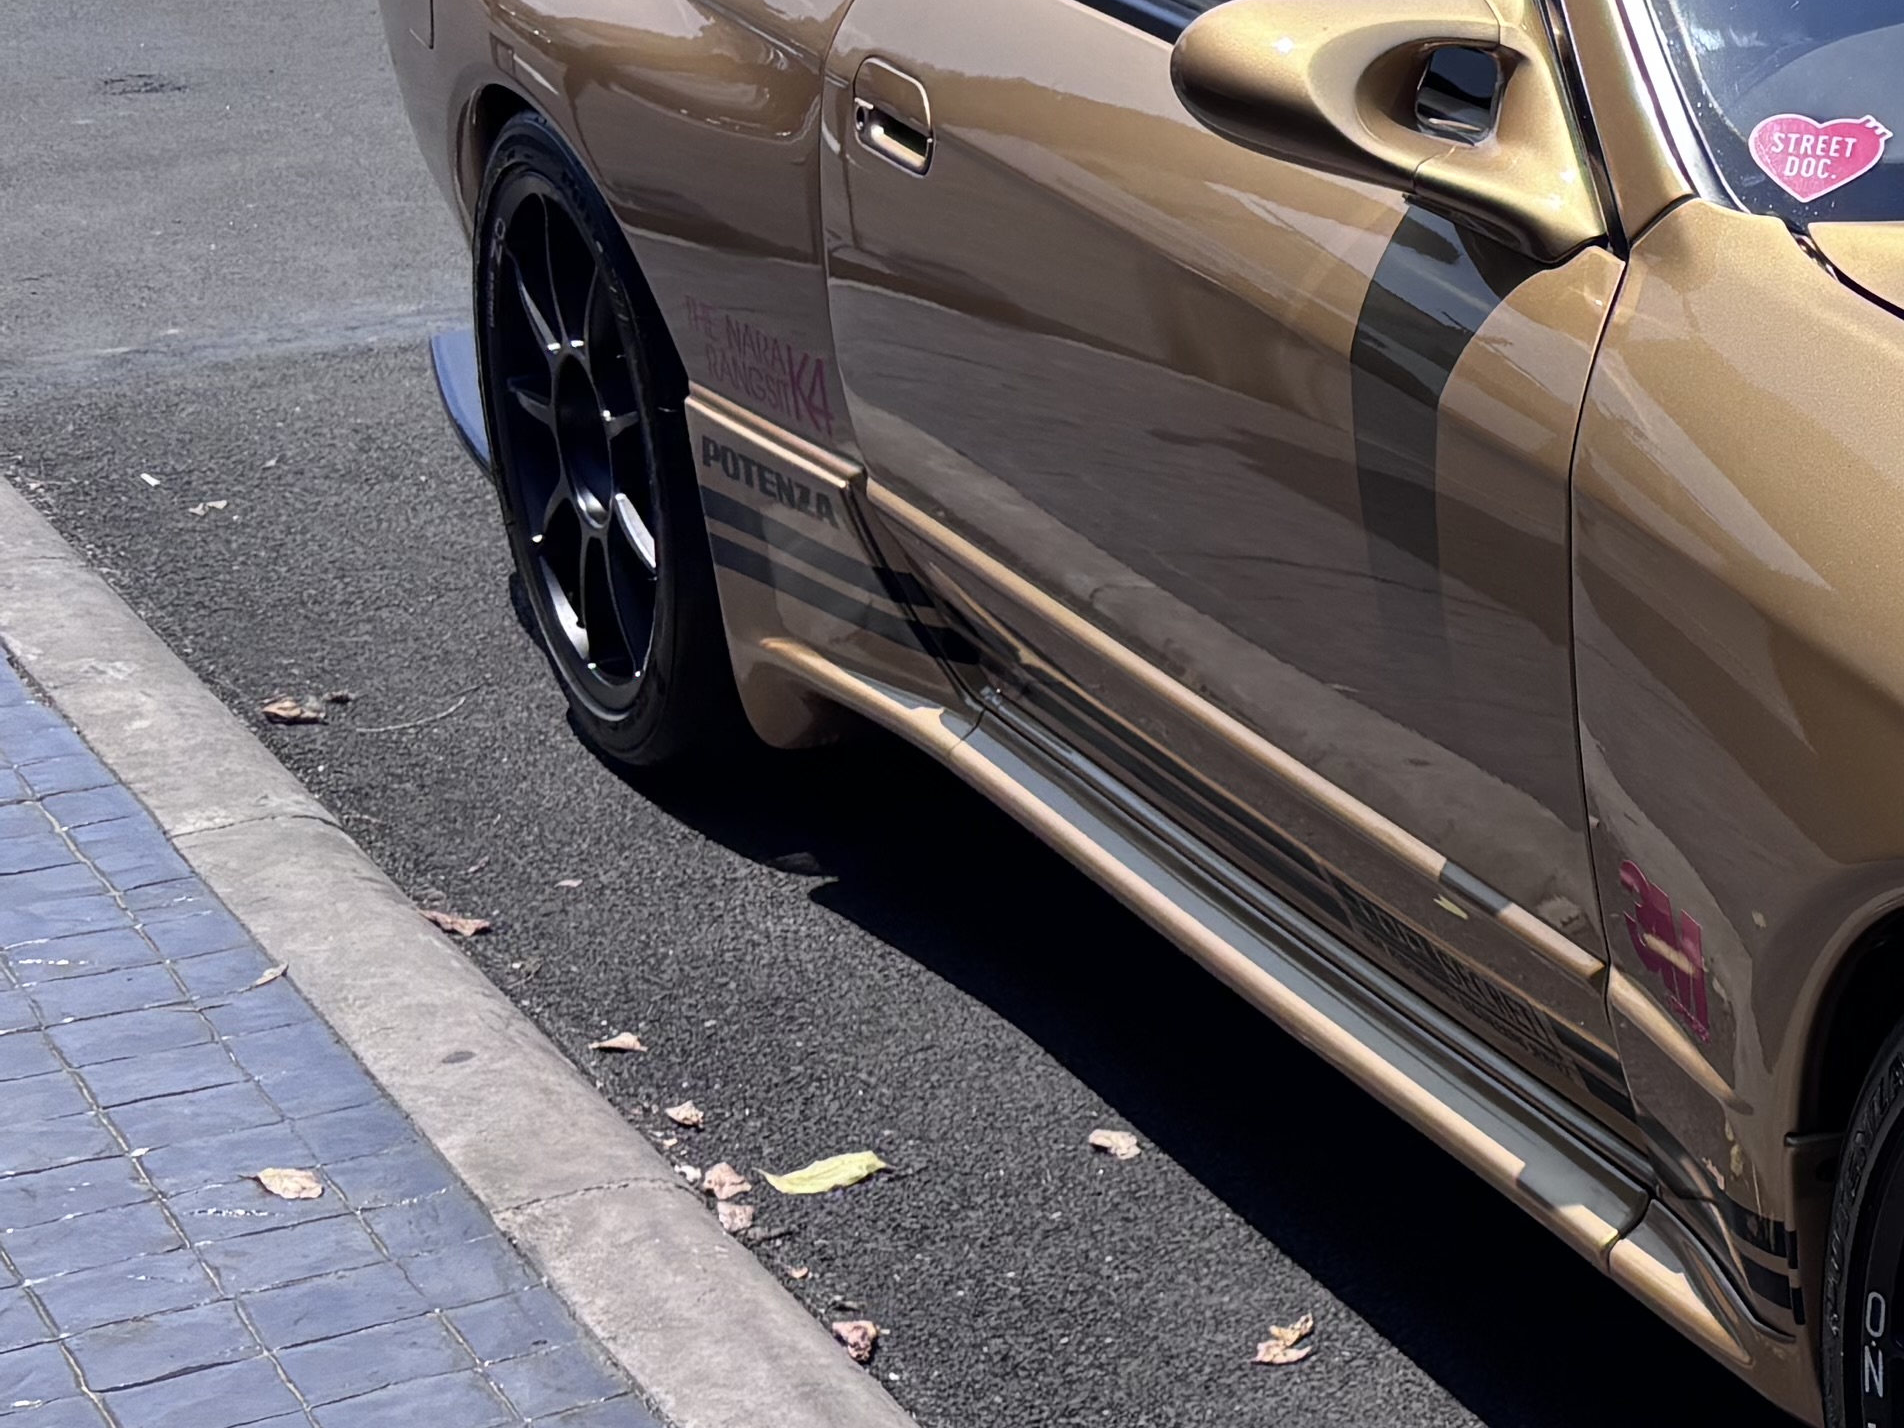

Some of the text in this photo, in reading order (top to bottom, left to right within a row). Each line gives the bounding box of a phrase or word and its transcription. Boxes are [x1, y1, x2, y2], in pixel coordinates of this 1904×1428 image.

[1771, 132, 1857, 159] STREET
[1784, 157, 1837, 180] DOC.
[702, 435, 839, 531] POTENZA
